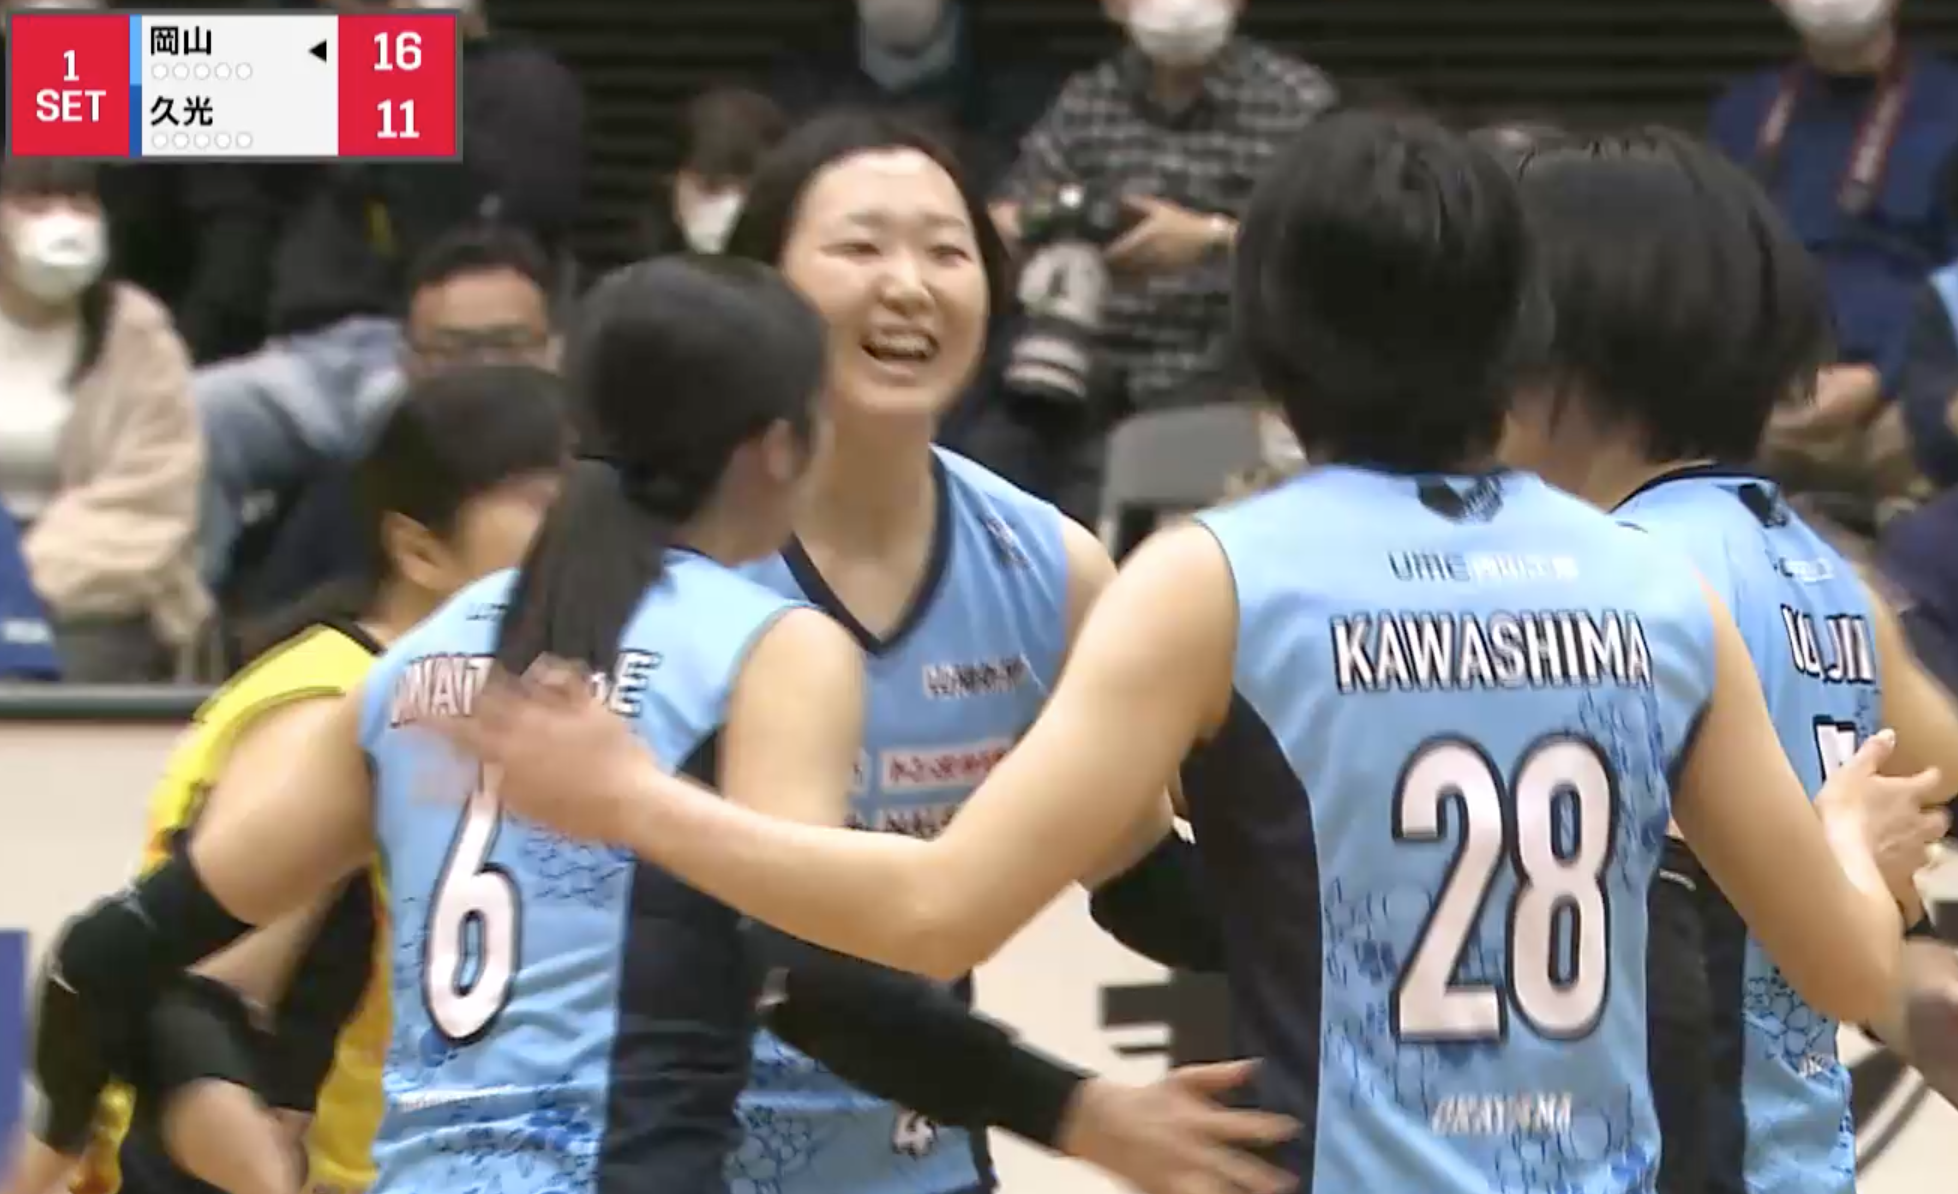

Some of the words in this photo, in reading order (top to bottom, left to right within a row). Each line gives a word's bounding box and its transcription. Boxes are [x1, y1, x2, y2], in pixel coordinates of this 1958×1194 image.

[1330, 609, 1654, 693] KAWASHIMA
[421, 765, 522, 1046] 6
[1390, 731, 1619, 1041] 28
